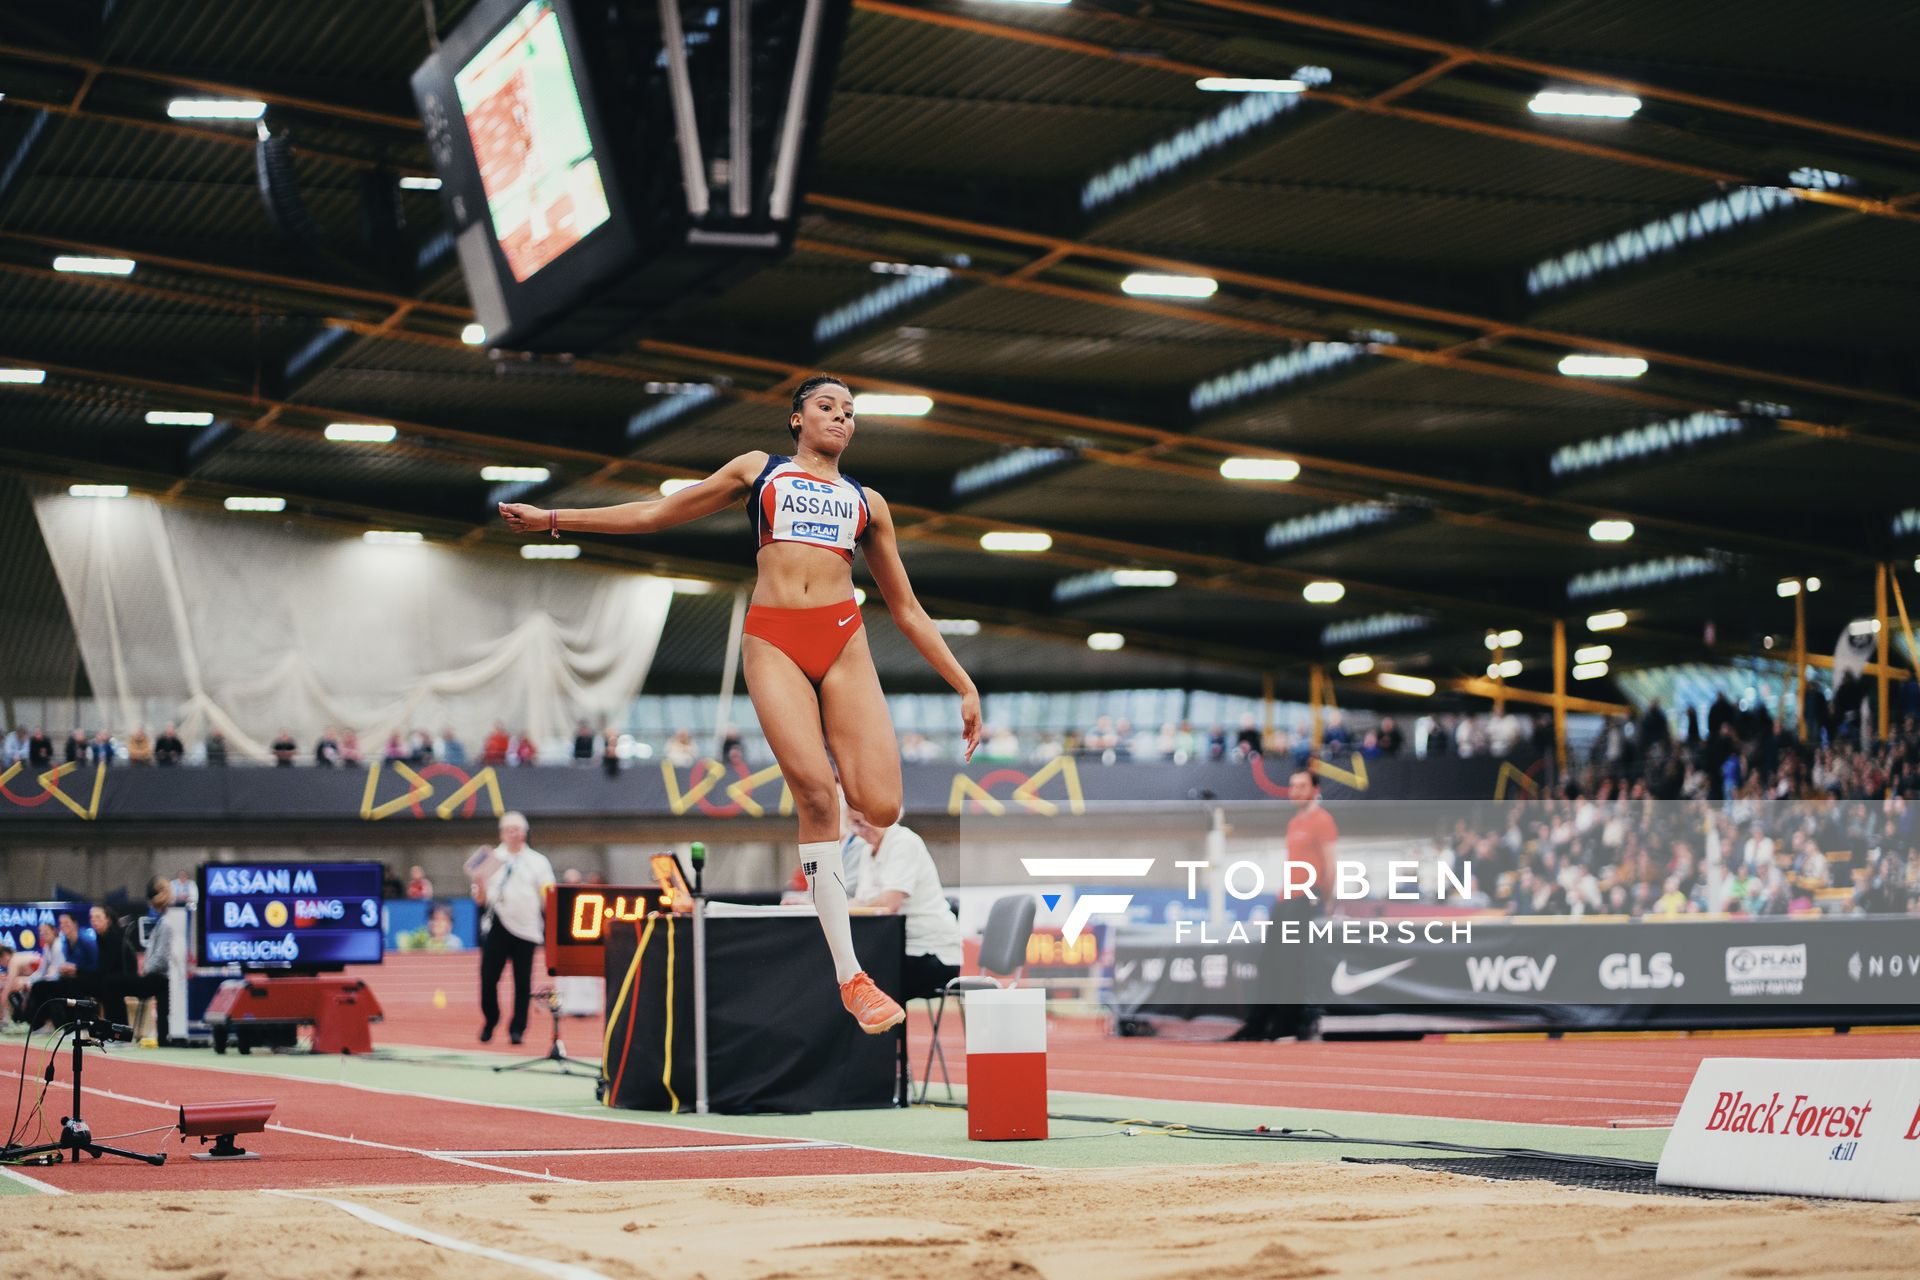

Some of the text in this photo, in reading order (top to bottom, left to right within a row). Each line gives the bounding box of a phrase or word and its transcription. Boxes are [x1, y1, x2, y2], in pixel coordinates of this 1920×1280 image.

[792, 479, 833, 494] GLS
[781, 494, 853, 519] ASSANI
[811, 525, 838, 536] PLAN
[209, 869, 317, 894] ASSANI M
[223, 899, 379, 928] BA RANG 3
[1760, 953, 1801, 966] PLAN
[1466, 953, 1557, 992] WGV
[1705, 1091, 1783, 1134] Black
[1780, 1095, 1872, 1138] Forest
